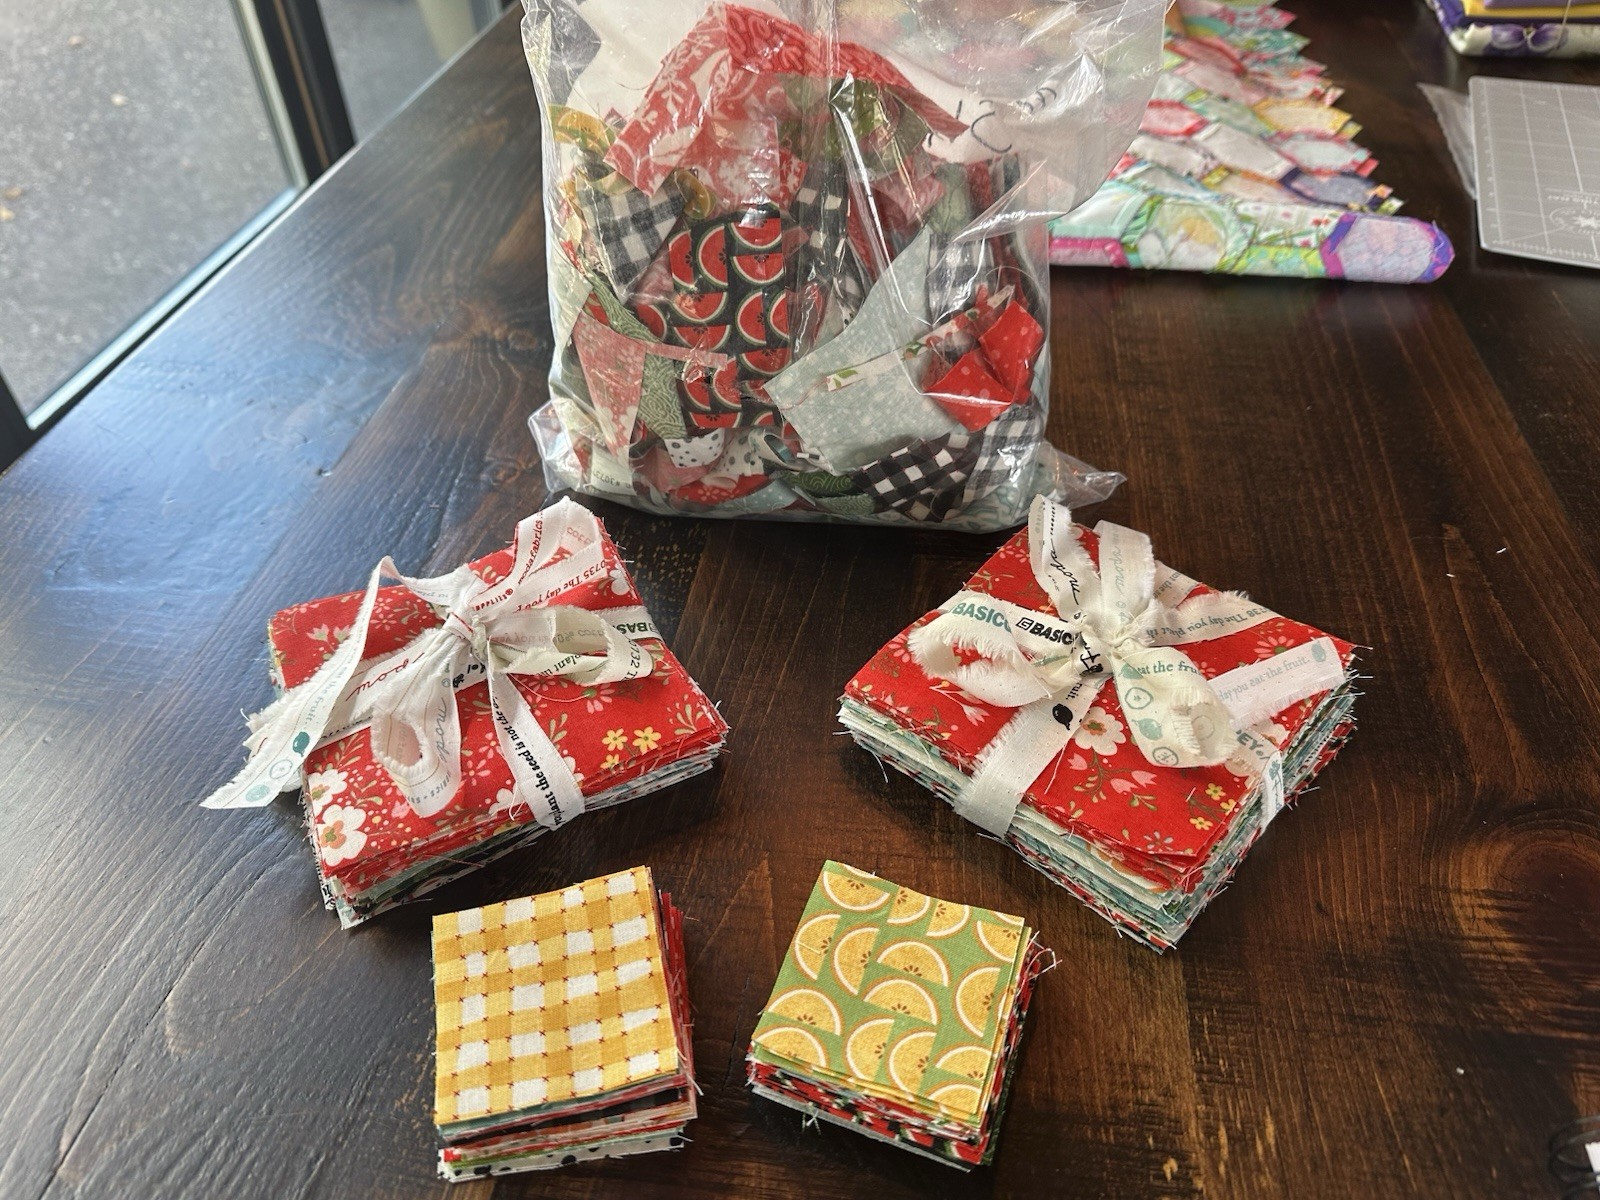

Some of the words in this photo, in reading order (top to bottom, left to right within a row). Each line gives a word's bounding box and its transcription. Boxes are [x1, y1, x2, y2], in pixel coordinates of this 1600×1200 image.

[563, 575, 585, 592] The
[545, 584, 562, 601] day
[1187, 620, 1207, 634] you
[1208, 615, 1225, 629] day
[1223, 612, 1246, 626] The
[618, 621, 648, 635] BAS
[1153, 661, 1174, 675] the
[345, 654, 418, 702] mod
[1232, 682, 1249, 697] you
[1249, 674, 1266, 687] eat
[1265, 667, 1283, 680] the
[1065, 683, 1083, 701] ruit.
[496, 710, 509, 725] the
[504, 724, 520, 741] not
[515, 741, 525, 751] is
[517, 750, 541, 772] seed
[535, 771, 550, 791] the
